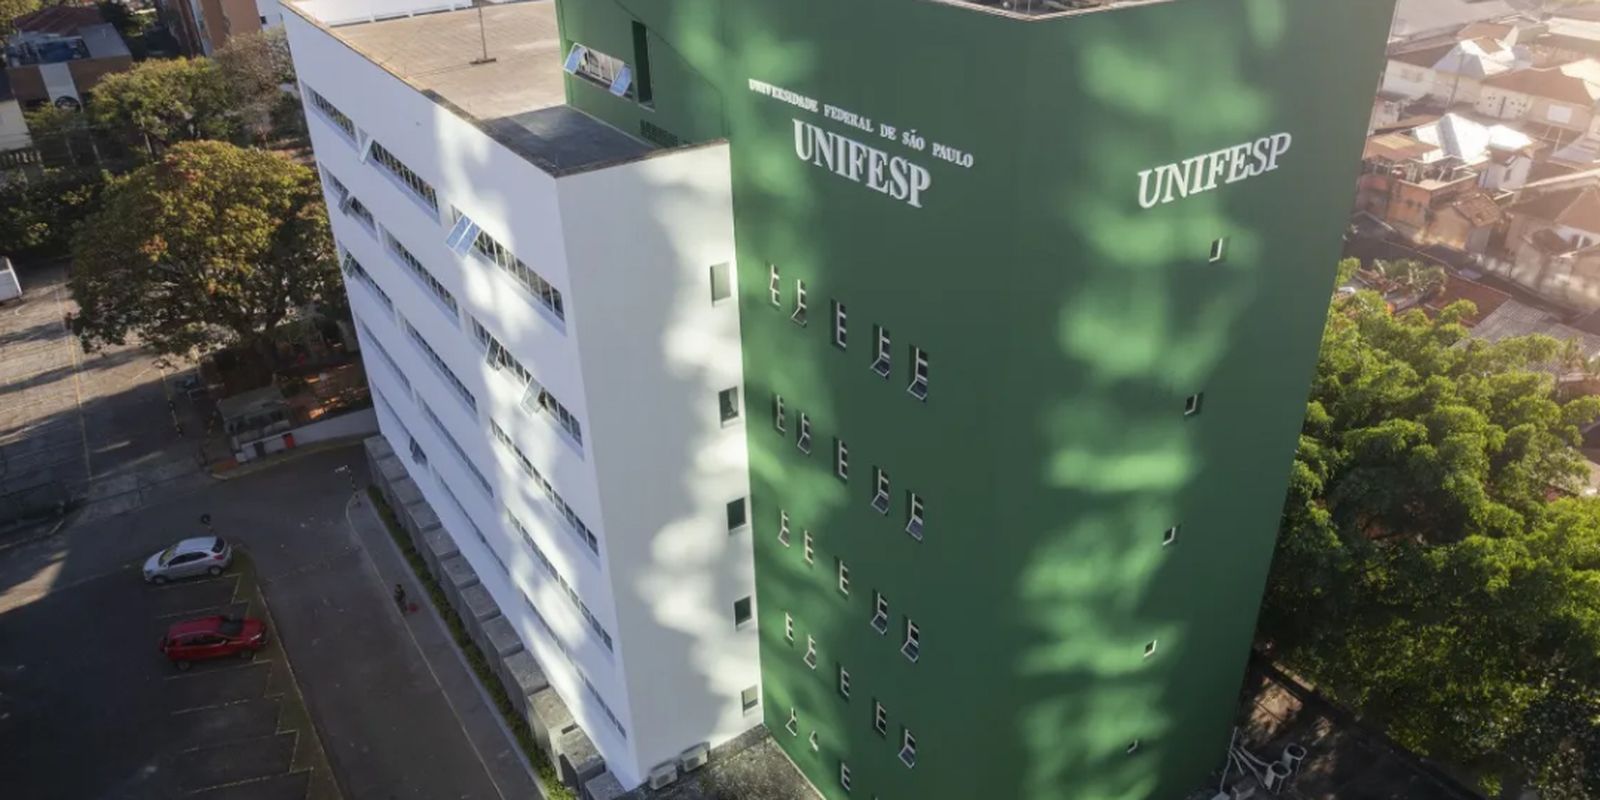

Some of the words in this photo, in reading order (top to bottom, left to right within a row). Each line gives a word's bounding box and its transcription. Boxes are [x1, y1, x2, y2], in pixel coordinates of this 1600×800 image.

[748, 78, 818, 112] UNIVERSIDADE
[824, 104, 874, 132] FEDERAL
[880, 124, 897, 141] DE
[902, 129, 926, 151] SÃO
[932, 142, 974, 168] PAULO
[792, 118, 931, 208] UNIFESP
[1137, 132, 1292, 209] UNIFESP
